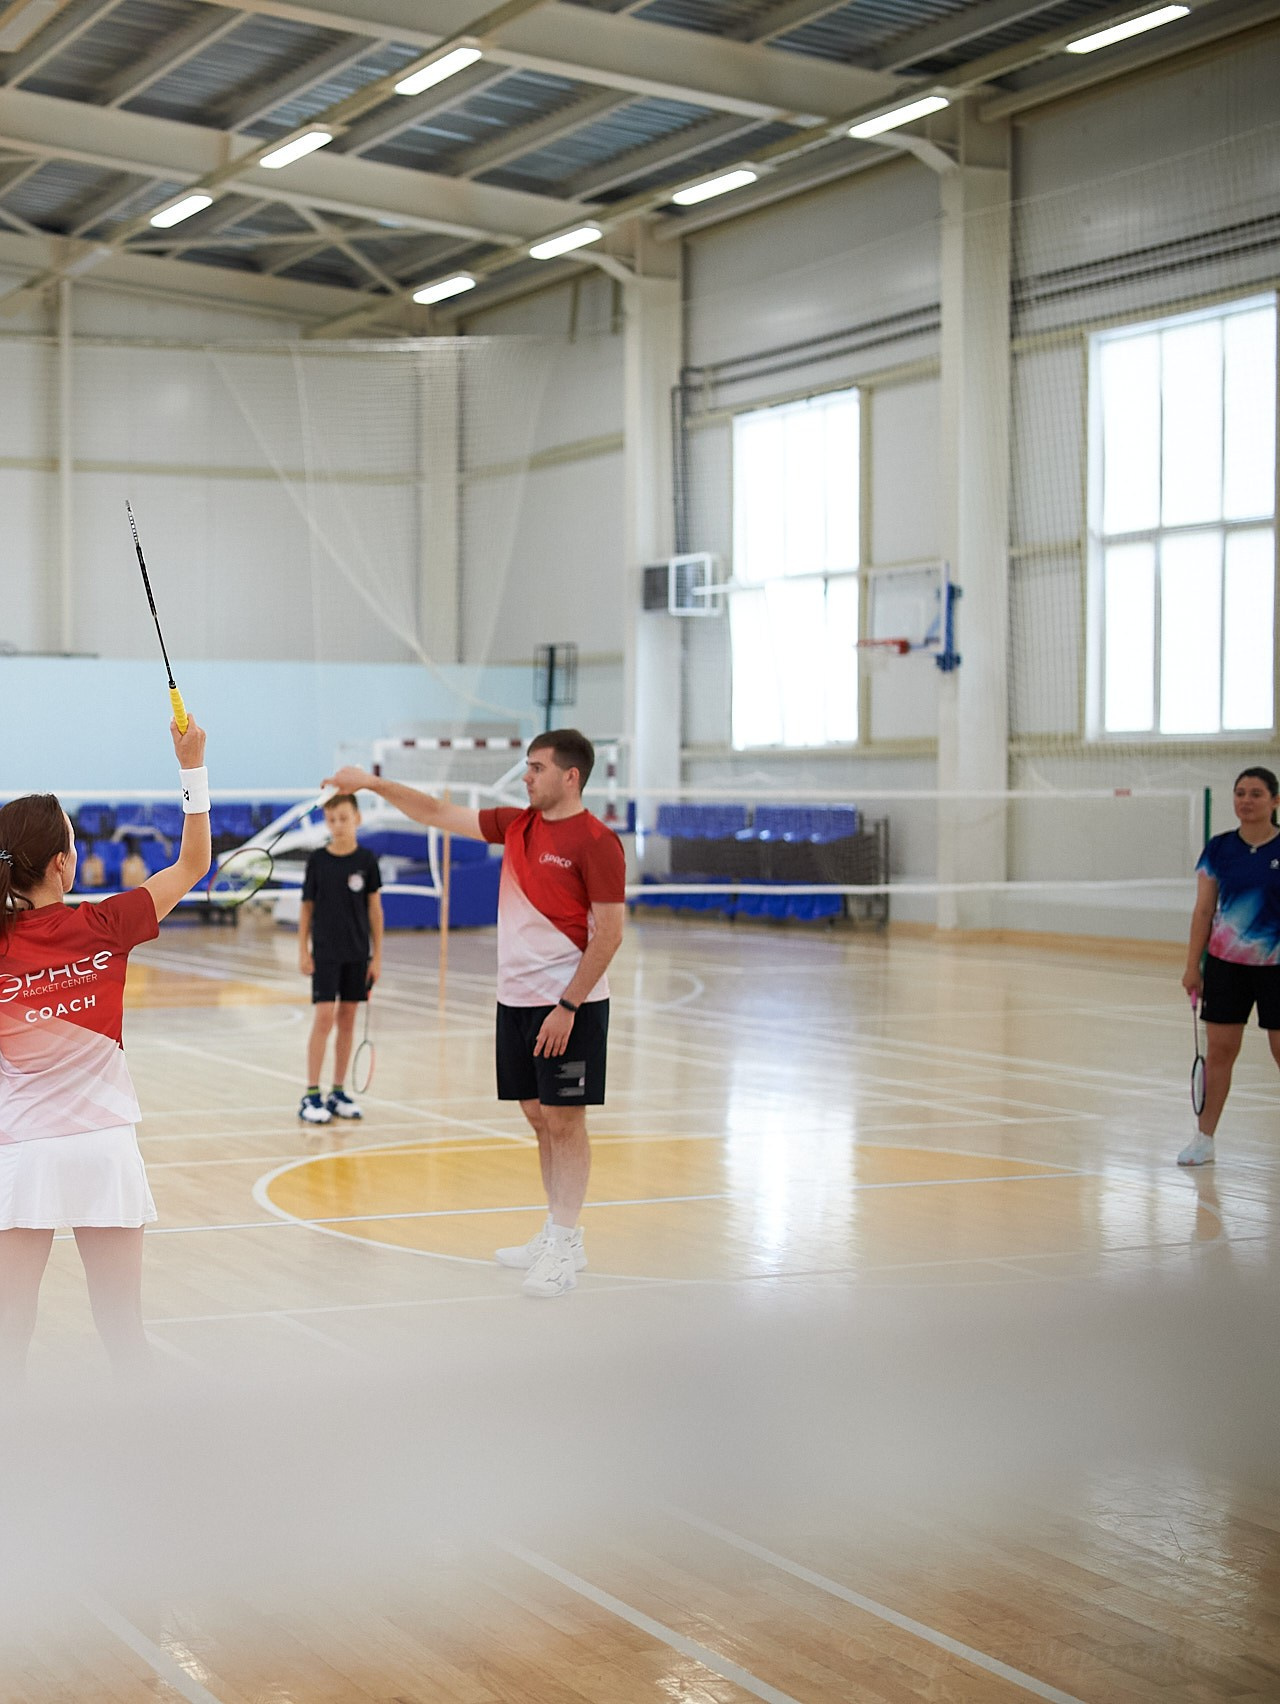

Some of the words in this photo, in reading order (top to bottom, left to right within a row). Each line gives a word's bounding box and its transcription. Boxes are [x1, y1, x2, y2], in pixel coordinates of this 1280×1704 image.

[23, 982, 59, 998] RACKET
[61, 973, 98, 989] CENTER
[25, 995, 96, 1023] COACH
